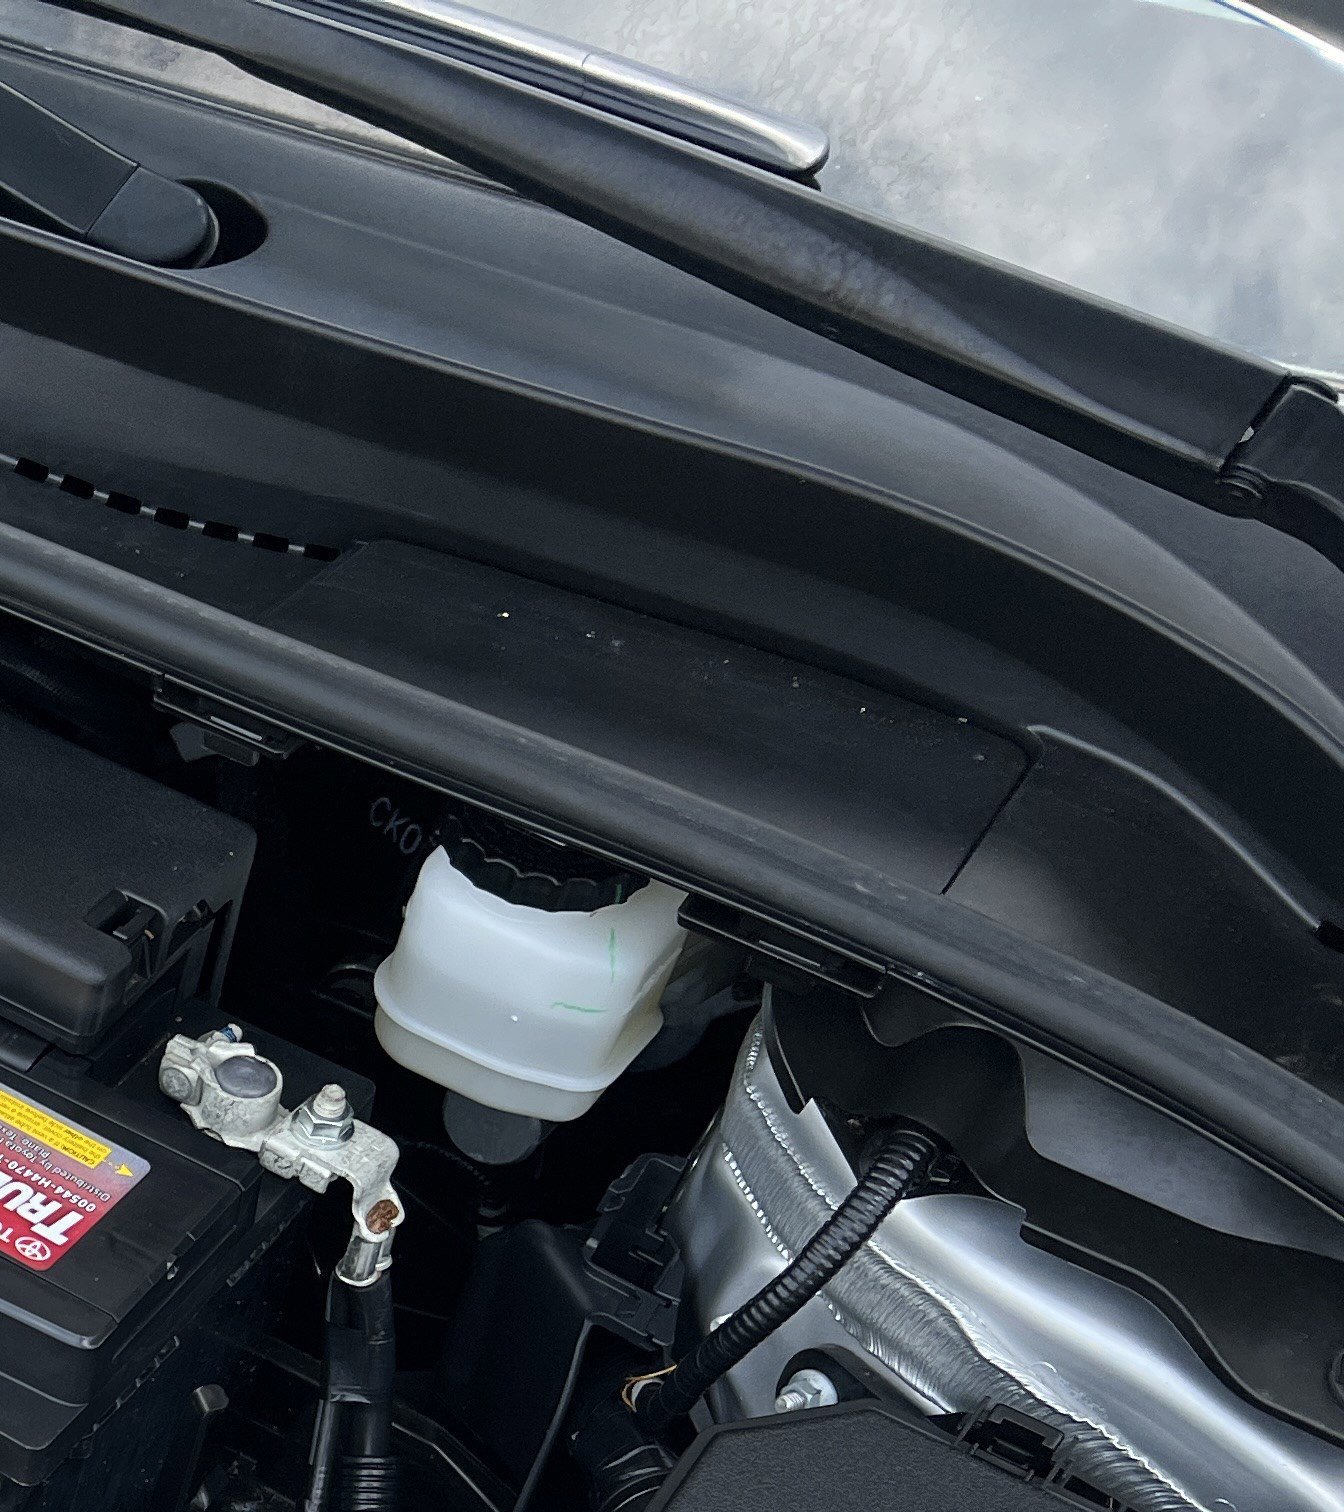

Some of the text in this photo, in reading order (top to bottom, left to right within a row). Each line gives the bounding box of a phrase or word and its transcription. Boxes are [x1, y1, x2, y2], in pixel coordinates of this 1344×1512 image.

[2, 1139, 39, 1162] Toyota
[37, 1158, 53, 1170] by
[50, 1166, 111, 1202] Distributed
